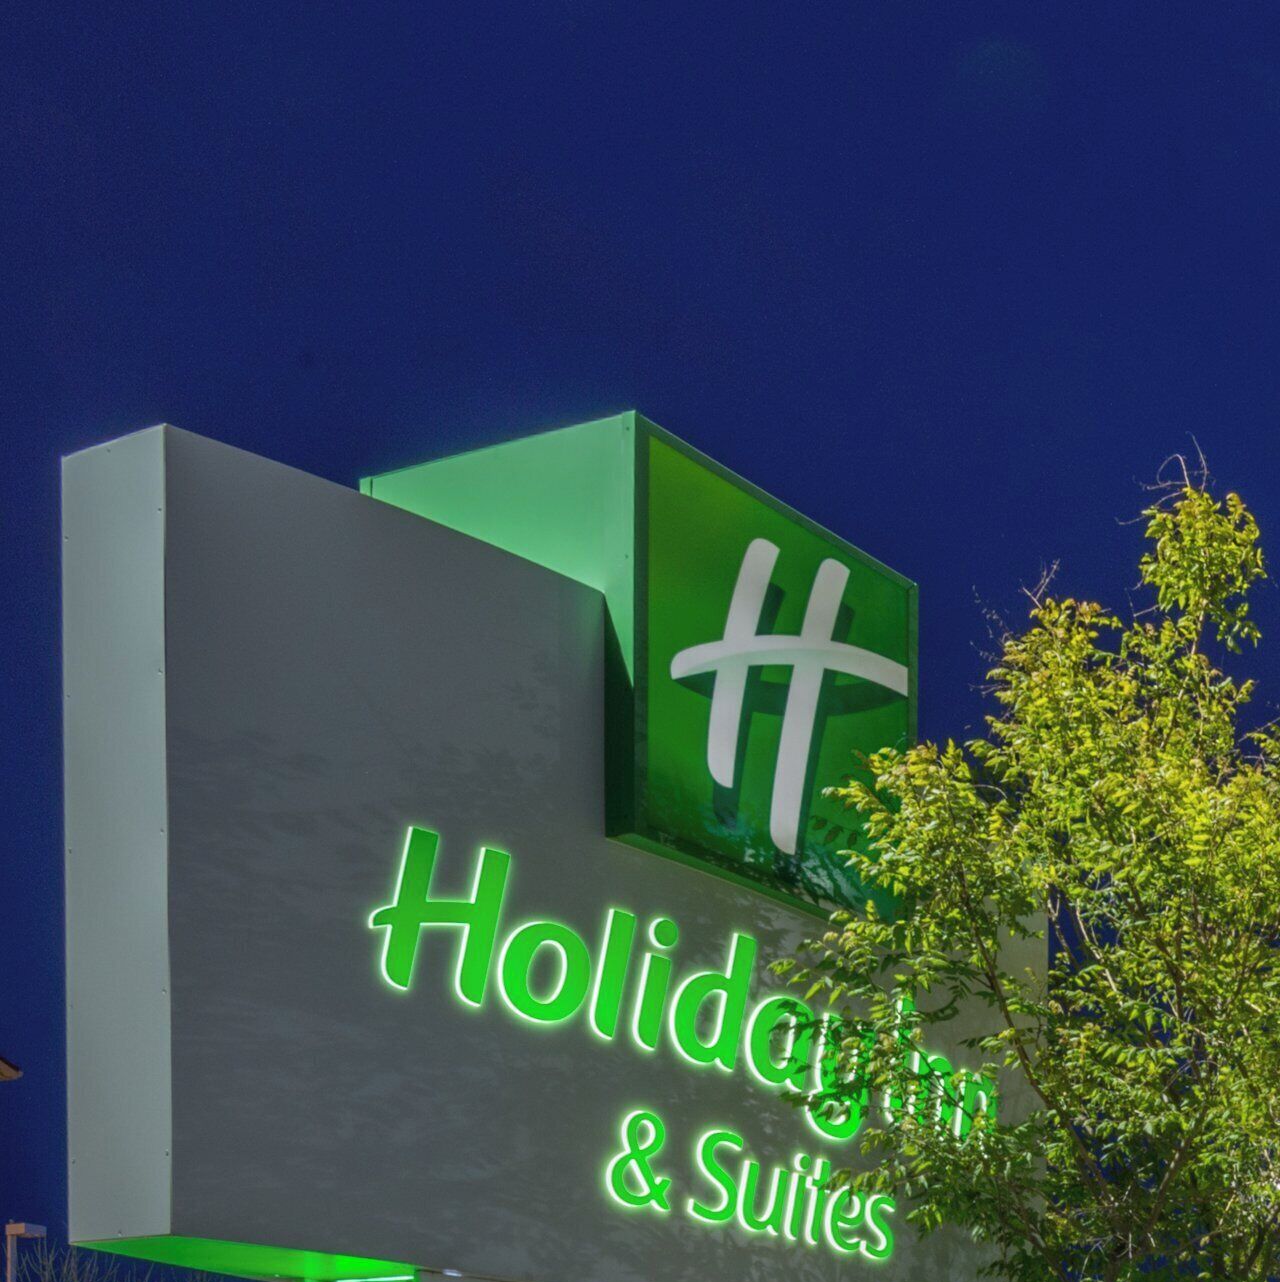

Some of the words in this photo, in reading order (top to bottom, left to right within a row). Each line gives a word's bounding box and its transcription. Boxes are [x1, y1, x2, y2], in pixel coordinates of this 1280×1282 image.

[368, 825, 878, 1140] Holiday
[605, 1109, 671, 1212] &
[686, 1128, 896, 1261] Suites
